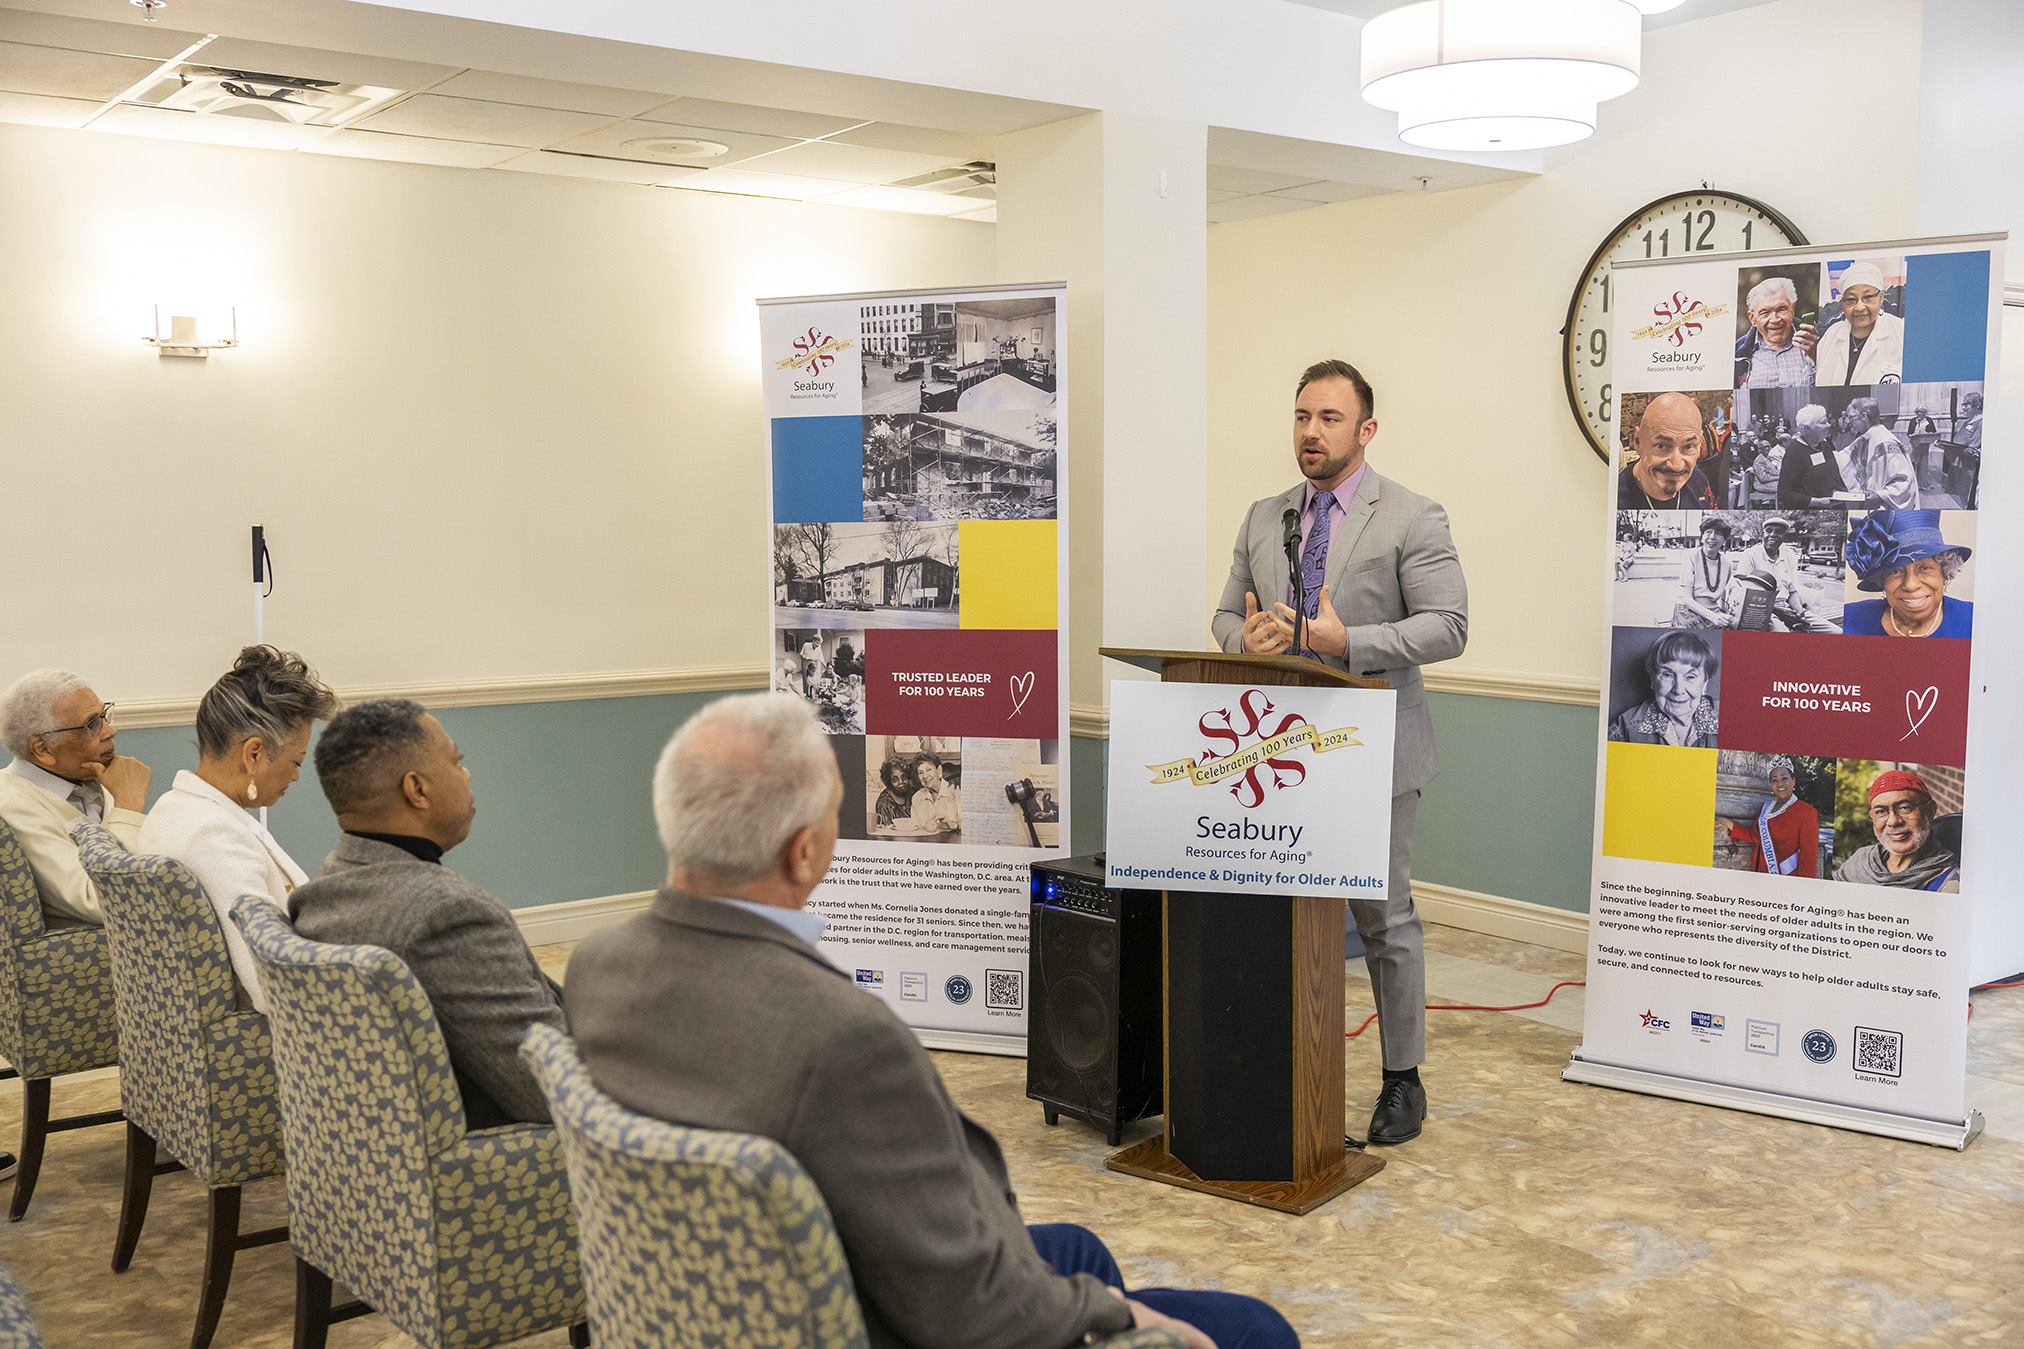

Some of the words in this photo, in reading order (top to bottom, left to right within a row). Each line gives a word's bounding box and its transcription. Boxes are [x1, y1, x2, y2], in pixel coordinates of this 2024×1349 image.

[1682, 210, 1716, 252] 12
[1742, 221, 1752, 250] 1
[1642, 228, 1668, 258] 11
[1590, 329, 1606, 367] 9
[1652, 352, 1701, 364] Seabury
[794, 381, 834, 392] Seabury
[892, 672, 944, 682] TRUSTED
[946, 673, 991, 682] LEADER
[899, 686, 922, 696] FOR
[924, 687, 944, 696] 100
[946, 687, 984, 696] YEARS
[1773, 682, 1861, 696] INNOVATIVE
[1762, 696, 1790, 708] FOR
[1794, 698, 1818, 710] 100
[1822, 700, 1871, 712] YEARS
[1162, 764, 1184, 778] 1924
[1196, 752, 1258, 781] Celebrating
[1261, 741, 1280, 758] 100
[1283, 730, 1313, 748] Years
[1324, 733, 1348, 746] 2024
[1197, 817, 1303, 848] Seabury
[1186, 846, 1246, 860] Resources
[1250, 847, 1266, 860] for
[852, 856, 891, 864] Resources
[975, 862, 1013, 871] providing
[874, 868, 899, 876] adults
[925, 871, 975, 880] Washington,
[1111, 866, 1206, 880] Independence
[1210, 870, 1219, 880] &
[1222, 870, 1272, 886] Dignity
[1276, 872, 1294, 884] for
[1298, 873, 1336, 886] Older
[1340, 875, 1383, 888] Adults
[882, 880, 898, 888] that
[1601, 881, 1624, 891] Since
[1626, 885, 1642, 893] the
[1644, 886, 1694, 900] beginning,
[1696, 893, 1736, 905] Seabury
[1738, 898, 1788, 910] Resources
[1791, 903, 1805, 912] for
[1847, 910, 1865, 919] has
[1868, 912, 1894, 923] been
[885, 904, 918, 912] Cornelia
[944, 907, 978, 915] donated
[865, 914, 902, 923] residence
[926, 918, 956, 926] seniors.
[958, 919, 980, 927] Since
[982, 921, 1003, 929] then,
[1600, 893, 1647, 906] innovative
[1649, 900, 1678, 910] leader
[1693, 907, 1717, 915] meet
[1720, 908, 1736, 917] the
[1738, 912, 1767, 921] needs
[1782, 916, 1808, 926] older
[1810, 920, 1842, 930] adults
[1845, 923, 1855, 932] in
[1858, 925, 1875, 934] the
[1878, 929, 1914, 939] region.
[1916, 932, 1933, 941] We
[904, 928, 929, 937] region
[944, 931, 1005, 941] transportation,
[1600, 908, 1621, 916] were
[1623, 911, 1655, 922] among
[1658, 914, 1673, 922] the
[1676, 916, 1694, 925] first
[1697, 920, 1766, 936] senior-serving
[1768, 929, 1837, 943] organizations
[1840, 937, 1850, 945] to
[1853, 940, 1879, 948] open
[1902, 945, 1932, 955] doors
[1935, 949, 1946, 957] to
[878, 939, 913, 947] wellness,
[951, 944, 1005, 952] management
[1599, 921, 1640, 931] everyone
[1642, 926, 1662, 934] who
[1664, 929, 1715, 941] represents
[1717, 935, 1733, 943] the
[1736, 937, 1778, 951] diversity
[1792, 944, 1809, 953] the
[1812, 947, 1851, 959] District.
[1597, 959, 1628, 969] secure,
[1631, 963, 1648, 971] and
[1650, 966, 1700, 978] connected
[1702, 972, 1712, 980] to
[1714, 975, 1763, 987] resources.
[1598, 944, 1626, 956] Today,
[1644, 952, 1685, 963] continue
[1688, 957, 1698, 965] to
[1700, 958, 1720, 968] look
[1723, 961, 1736, 970] for
[1739, 965, 1760, 973] new
[1762, 968, 1786, 978] ways
[1789, 971, 1800, 979] to
[1802, 972, 1824, 984] help
[1827, 976, 1854, 986] older
[1856, 981, 1889, 991] adults
[1892, 986, 1914, 996] stay
[1916, 990, 1940, 999] safe,
[953, 986, 964, 994] 23
[1006, 1010, 1022, 1018] More
[1692, 1012, 1710, 1021] United
[1651, 1019, 1670, 1028] CFC
[1698, 1019, 1710, 1028] Way
[1812, 1041, 1826, 1052] 23
[1855, 1074, 1876, 1082] Learn
[1878, 1078, 1898, 1086] More
